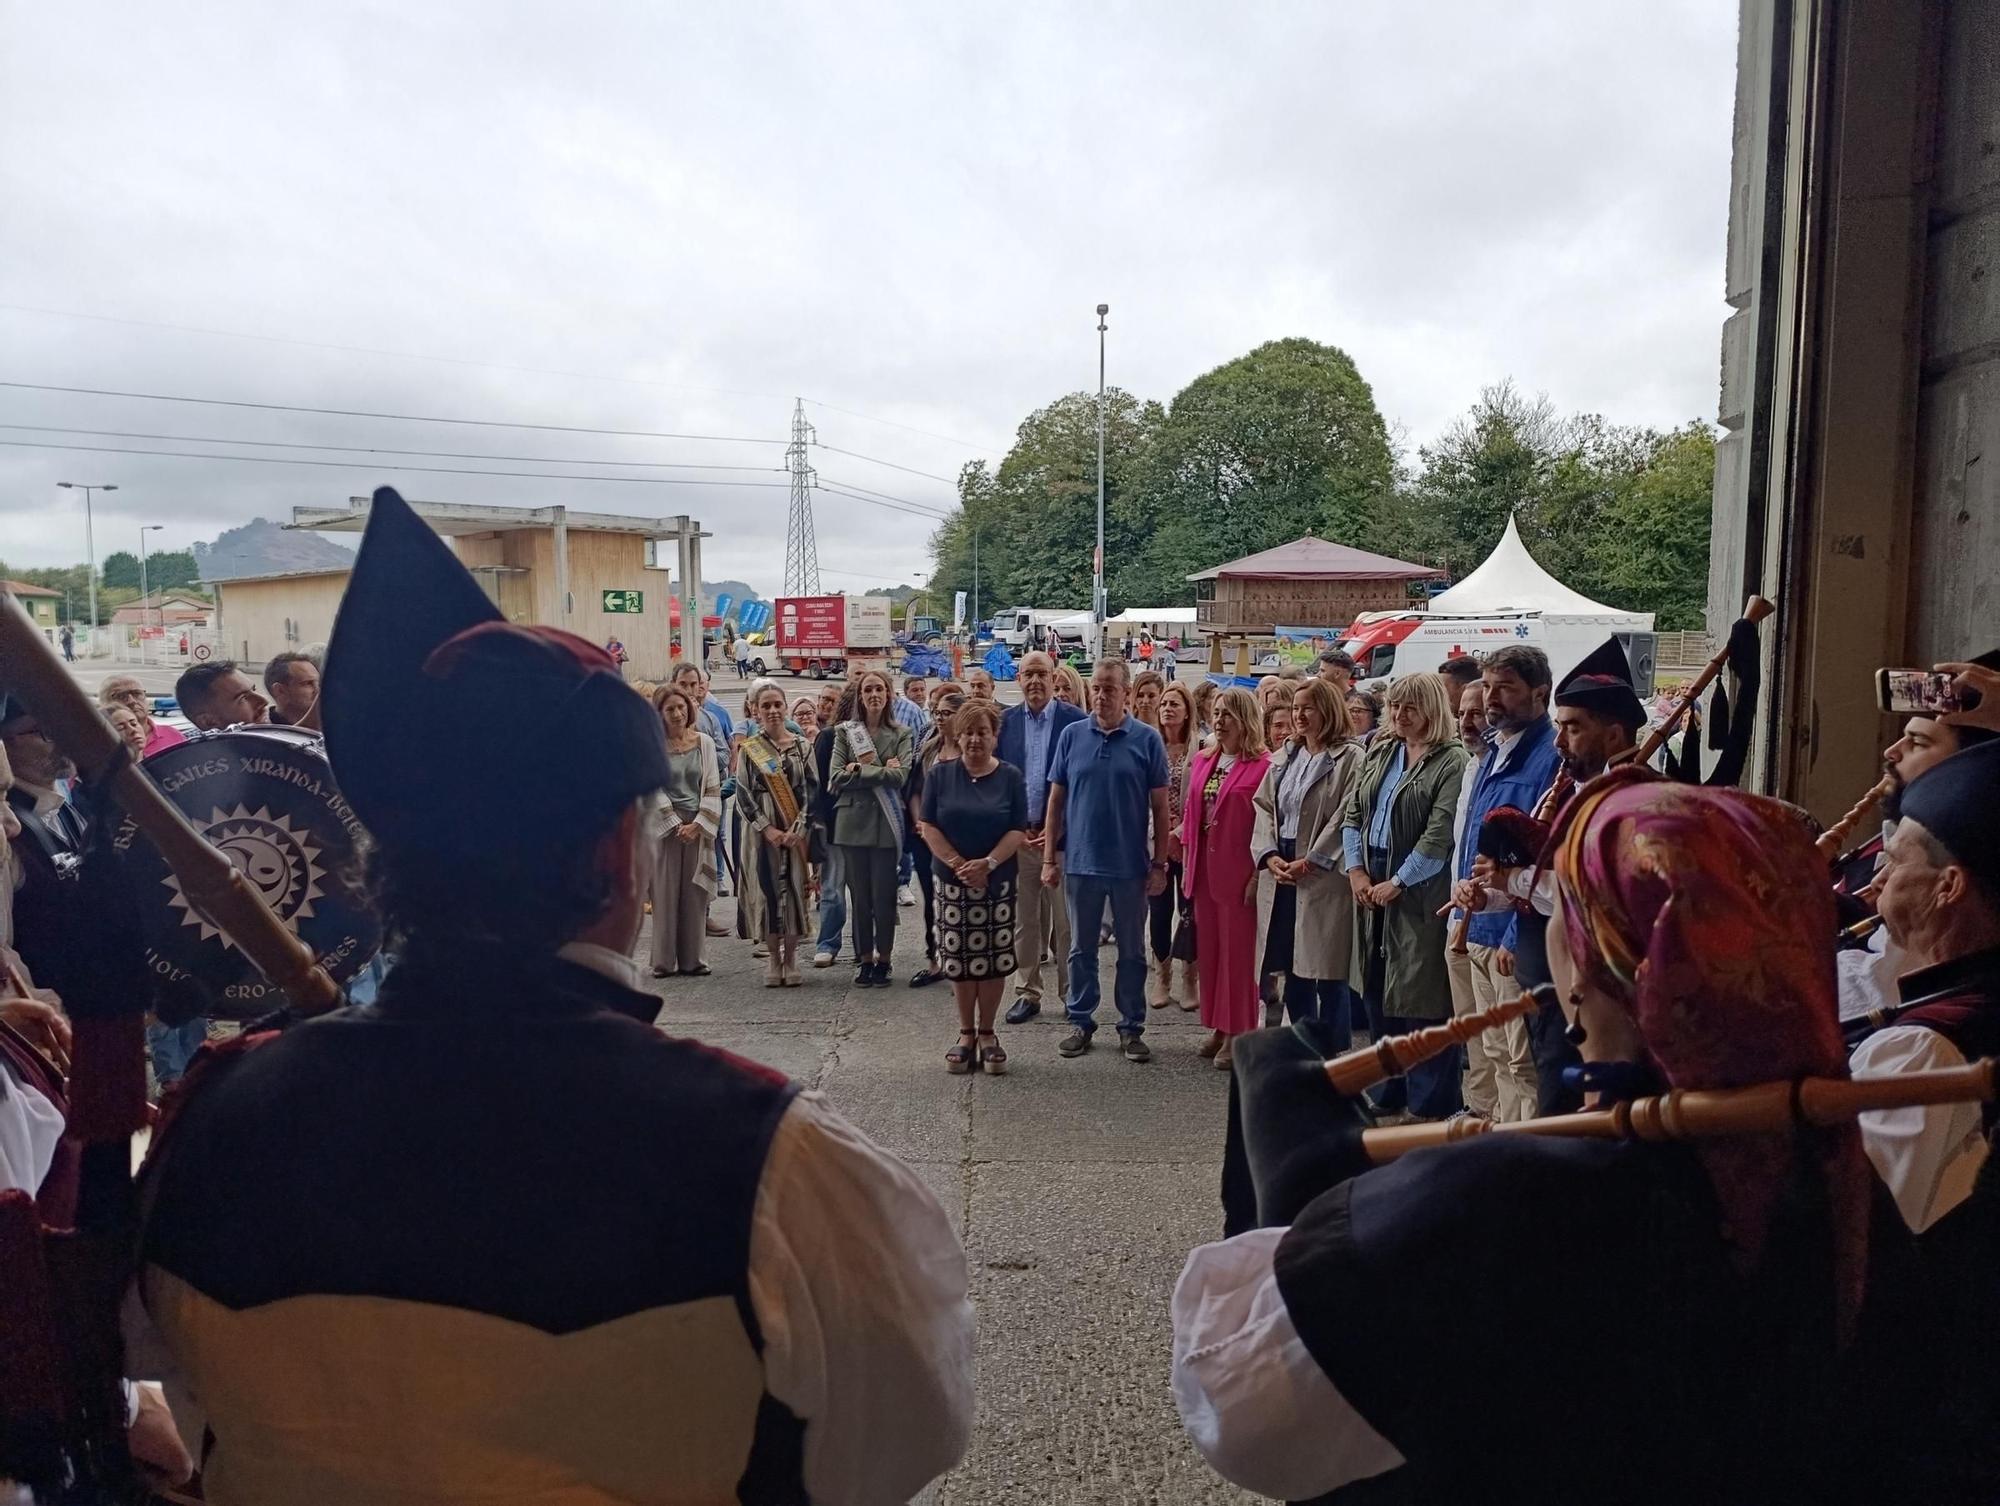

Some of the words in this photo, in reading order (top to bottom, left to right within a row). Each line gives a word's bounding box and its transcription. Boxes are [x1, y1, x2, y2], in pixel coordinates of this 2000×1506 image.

[1424, 627, 1463, 635] AMBULANCIA
[162, 757, 230, 792] GAITES
[240, 757, 365, 843] XIRANDA-BELE
